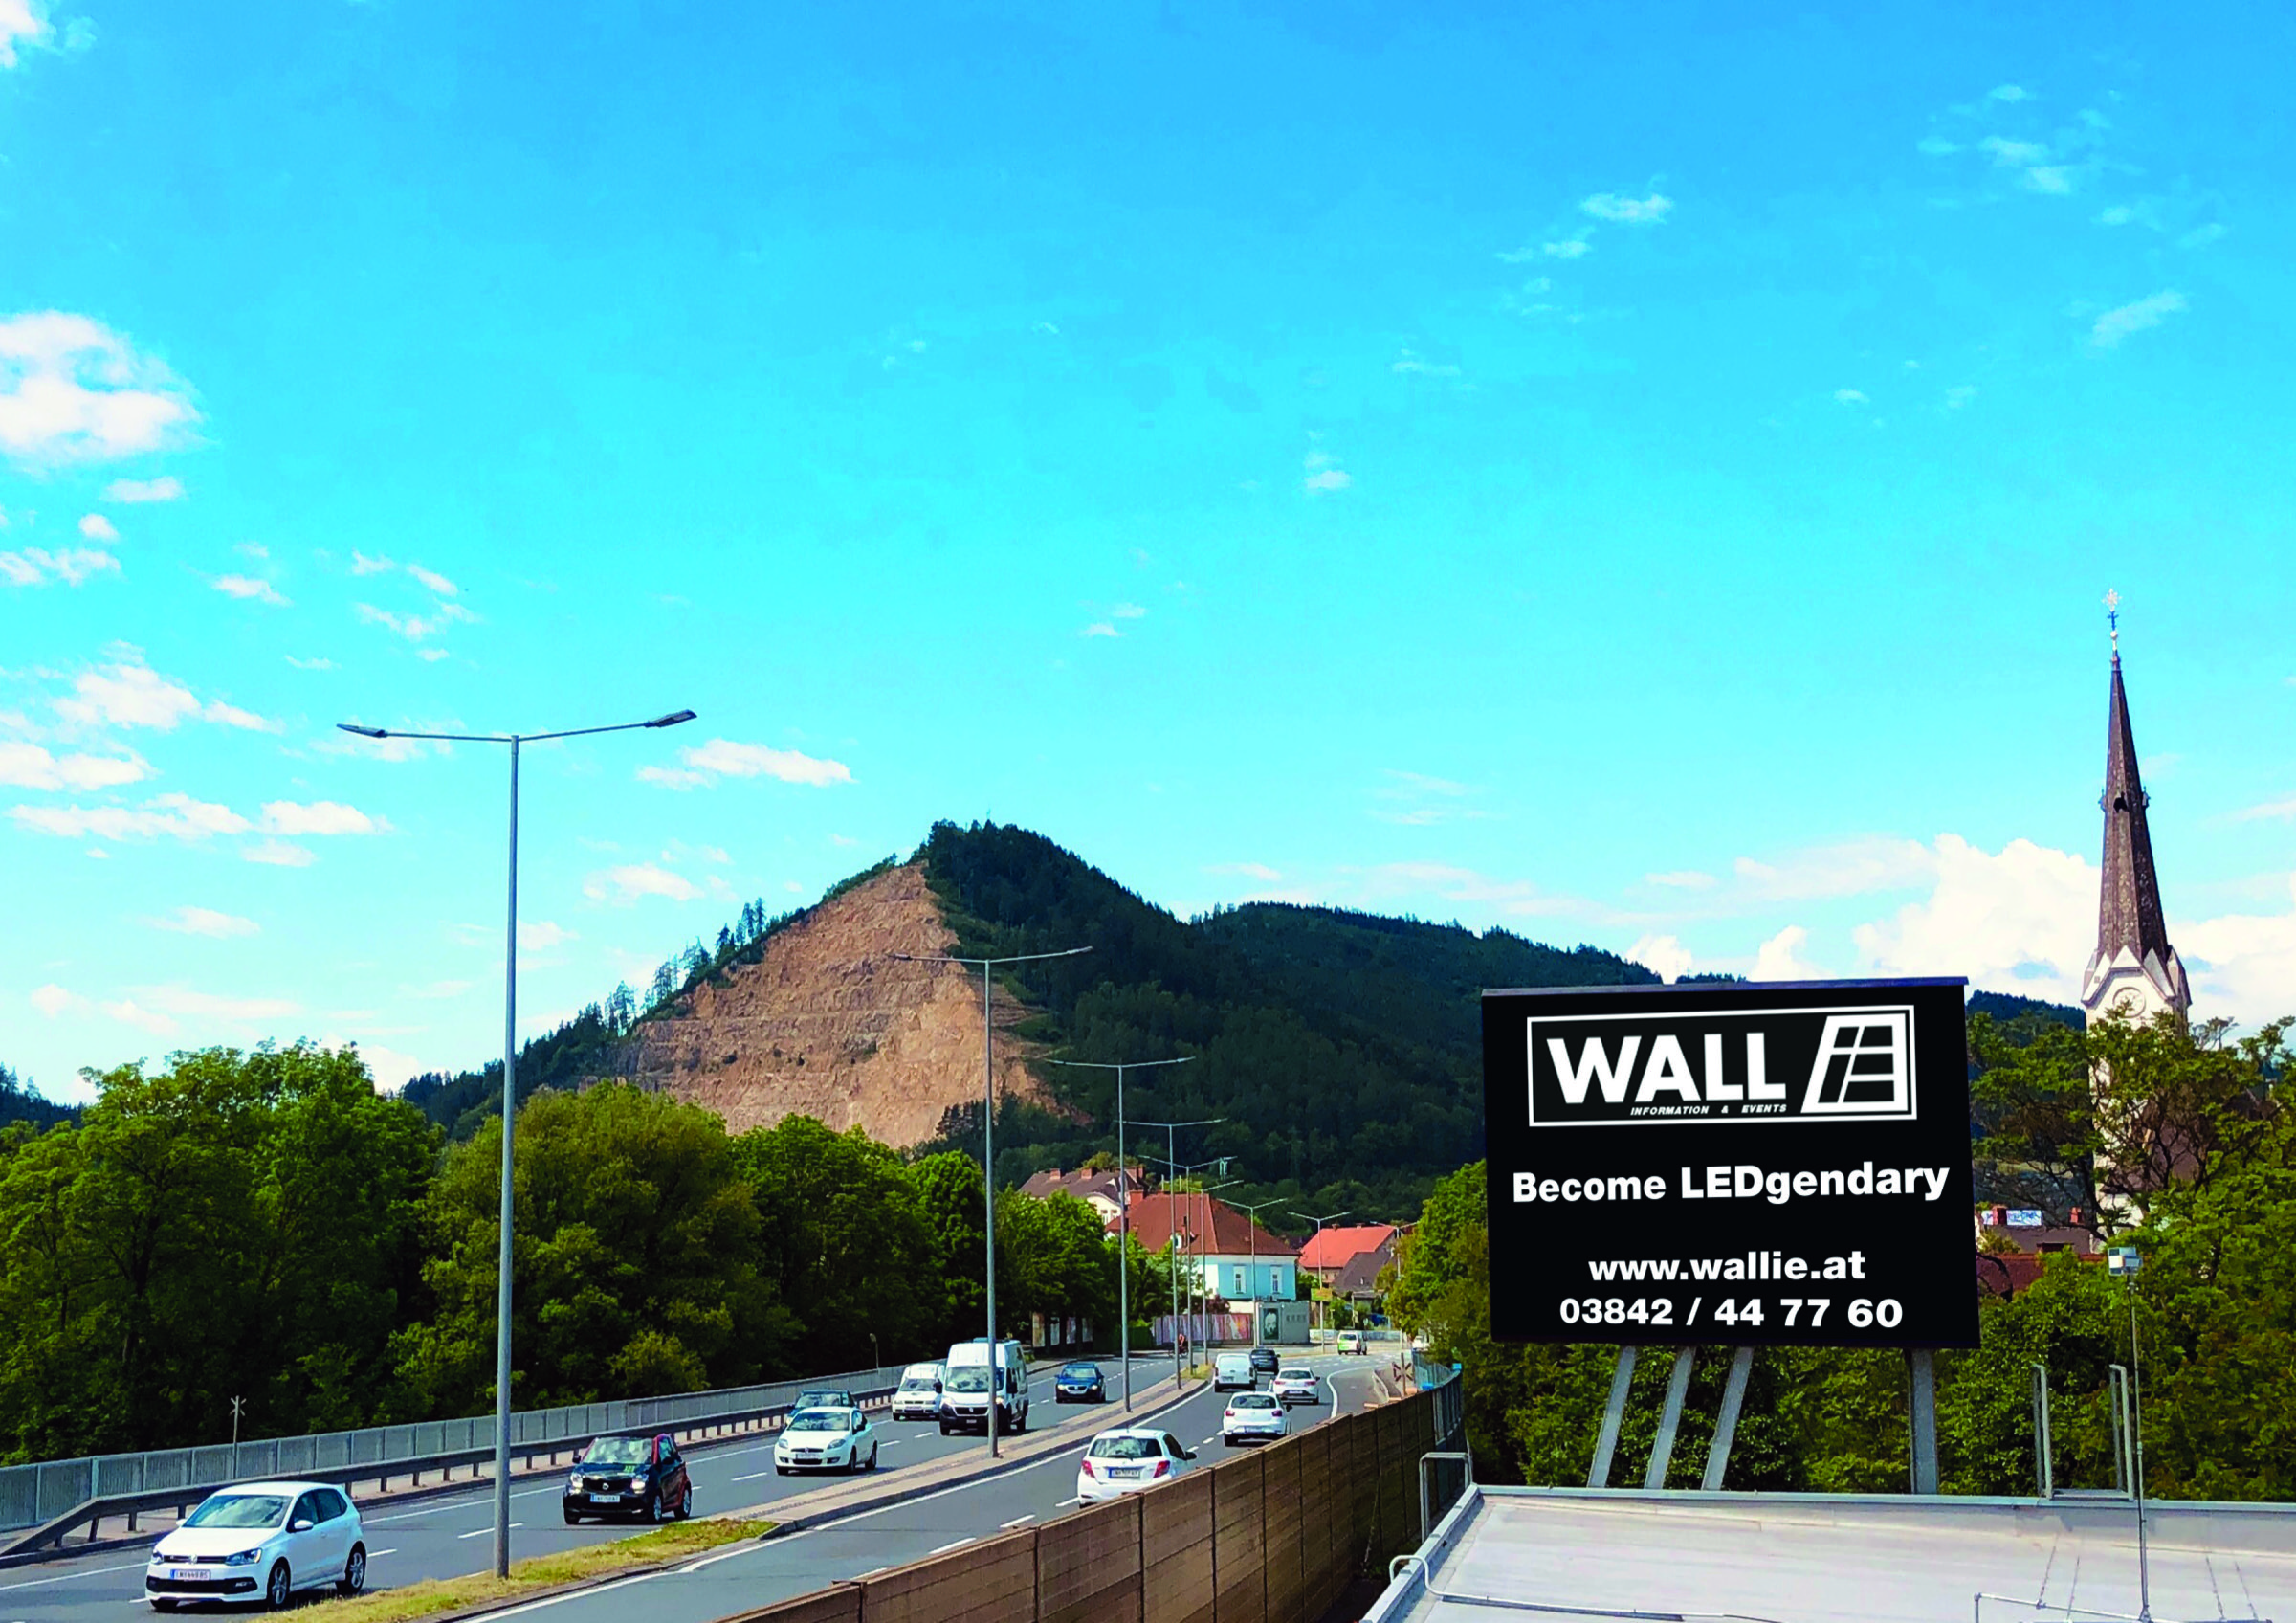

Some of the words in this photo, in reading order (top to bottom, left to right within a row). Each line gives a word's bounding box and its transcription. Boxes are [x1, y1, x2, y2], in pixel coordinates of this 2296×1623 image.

[1546, 1032, 1787, 1104] WALL
[1630, 1105, 1710, 1116] INFORMATION
[1720, 1104, 1729, 1114] &
[1741, 1103, 1787, 1114] EVENTS
[1512, 1172, 1666, 1203] Become
[1681, 1161, 1951, 1205] LEDgendary
[1588, 1251, 1866, 1280] www.wallie.at
[1559, 1299, 1673, 1325] 03842
[1686, 1297, 1702, 1326] /
[1714, 1299, 1765, 1326] 44
[1779, 1299, 1831, 1327] 77
[1847, 1299, 1903, 1328] 60
